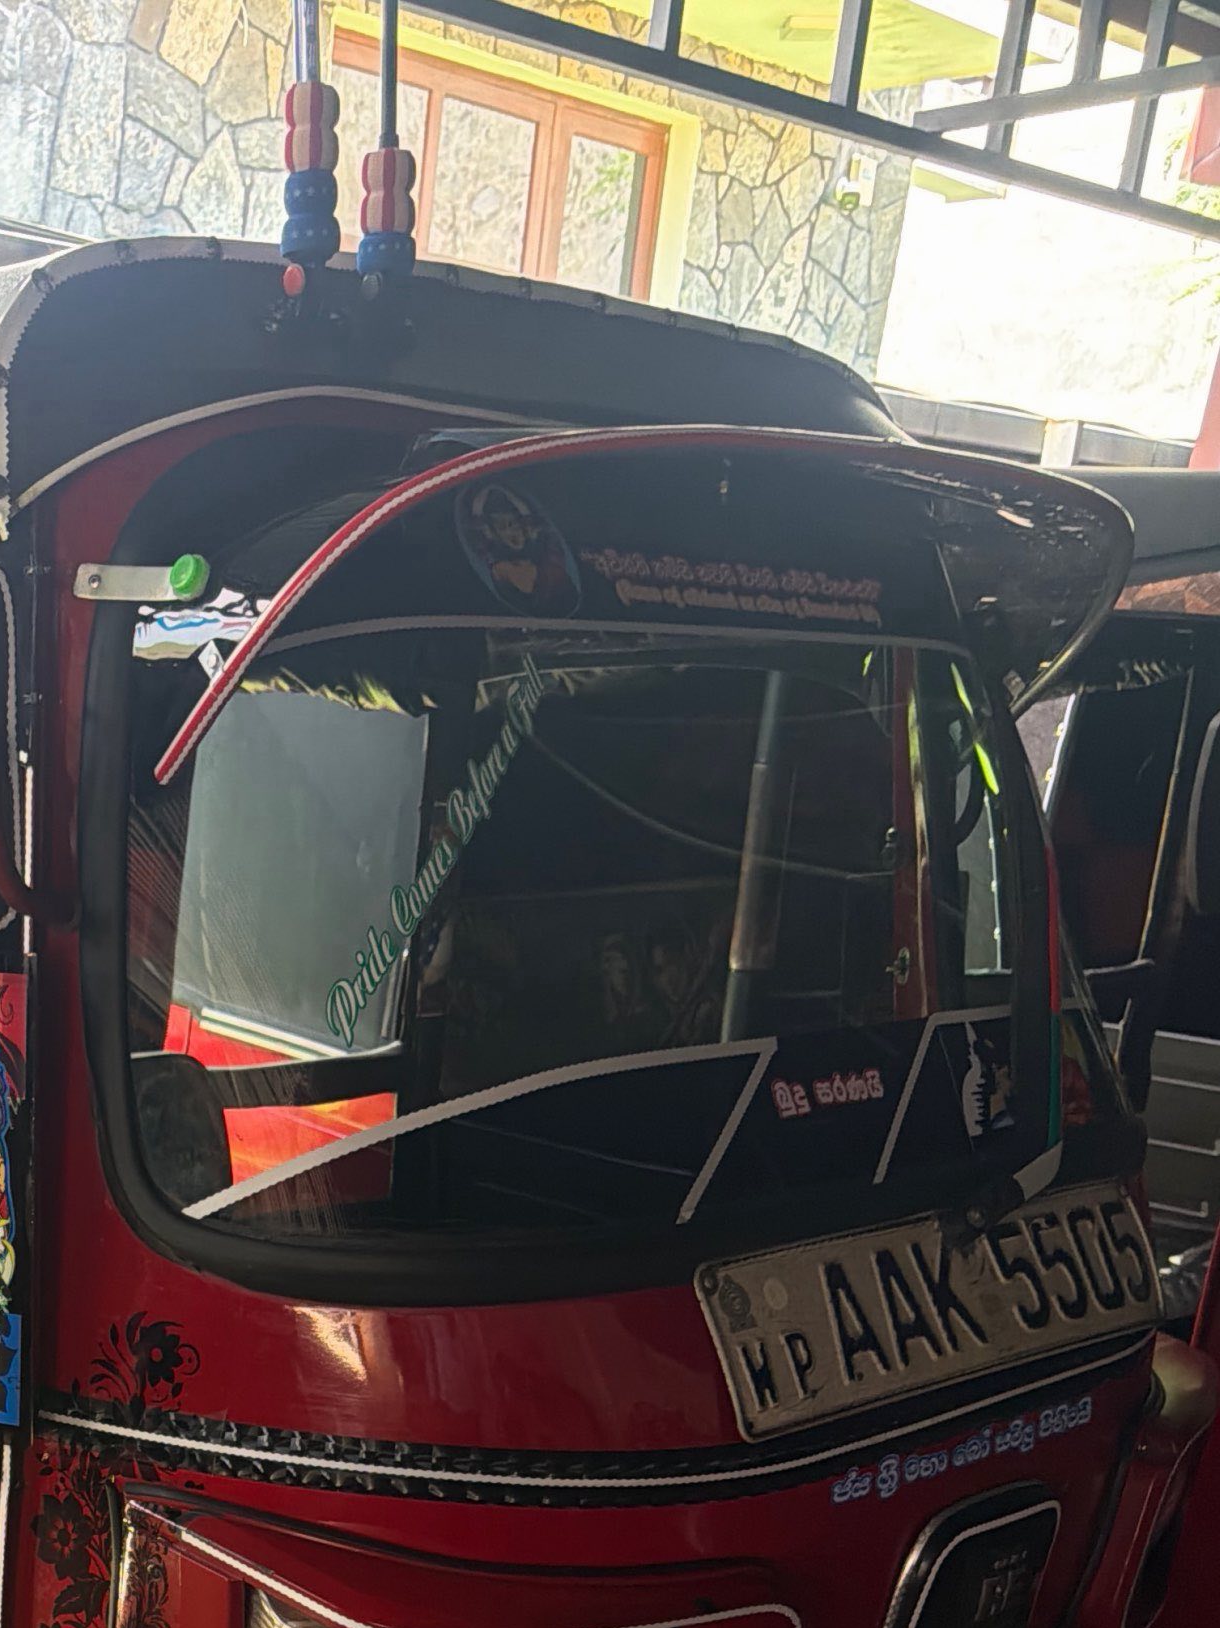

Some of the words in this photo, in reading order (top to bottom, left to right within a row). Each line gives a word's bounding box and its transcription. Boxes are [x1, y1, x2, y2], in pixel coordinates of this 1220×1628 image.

[500, 721, 520, 755] a
[507, 653, 545, 736] Fall
[447, 744, 512, 846] Before
[390, 836, 458, 938] Comes
[326, 925, 398, 1048] Pride
[771, 1078, 811, 1119] බුදු
[820, 1241, 989, 1385] AAK
[983, 1202, 1153, 1331] 5505
